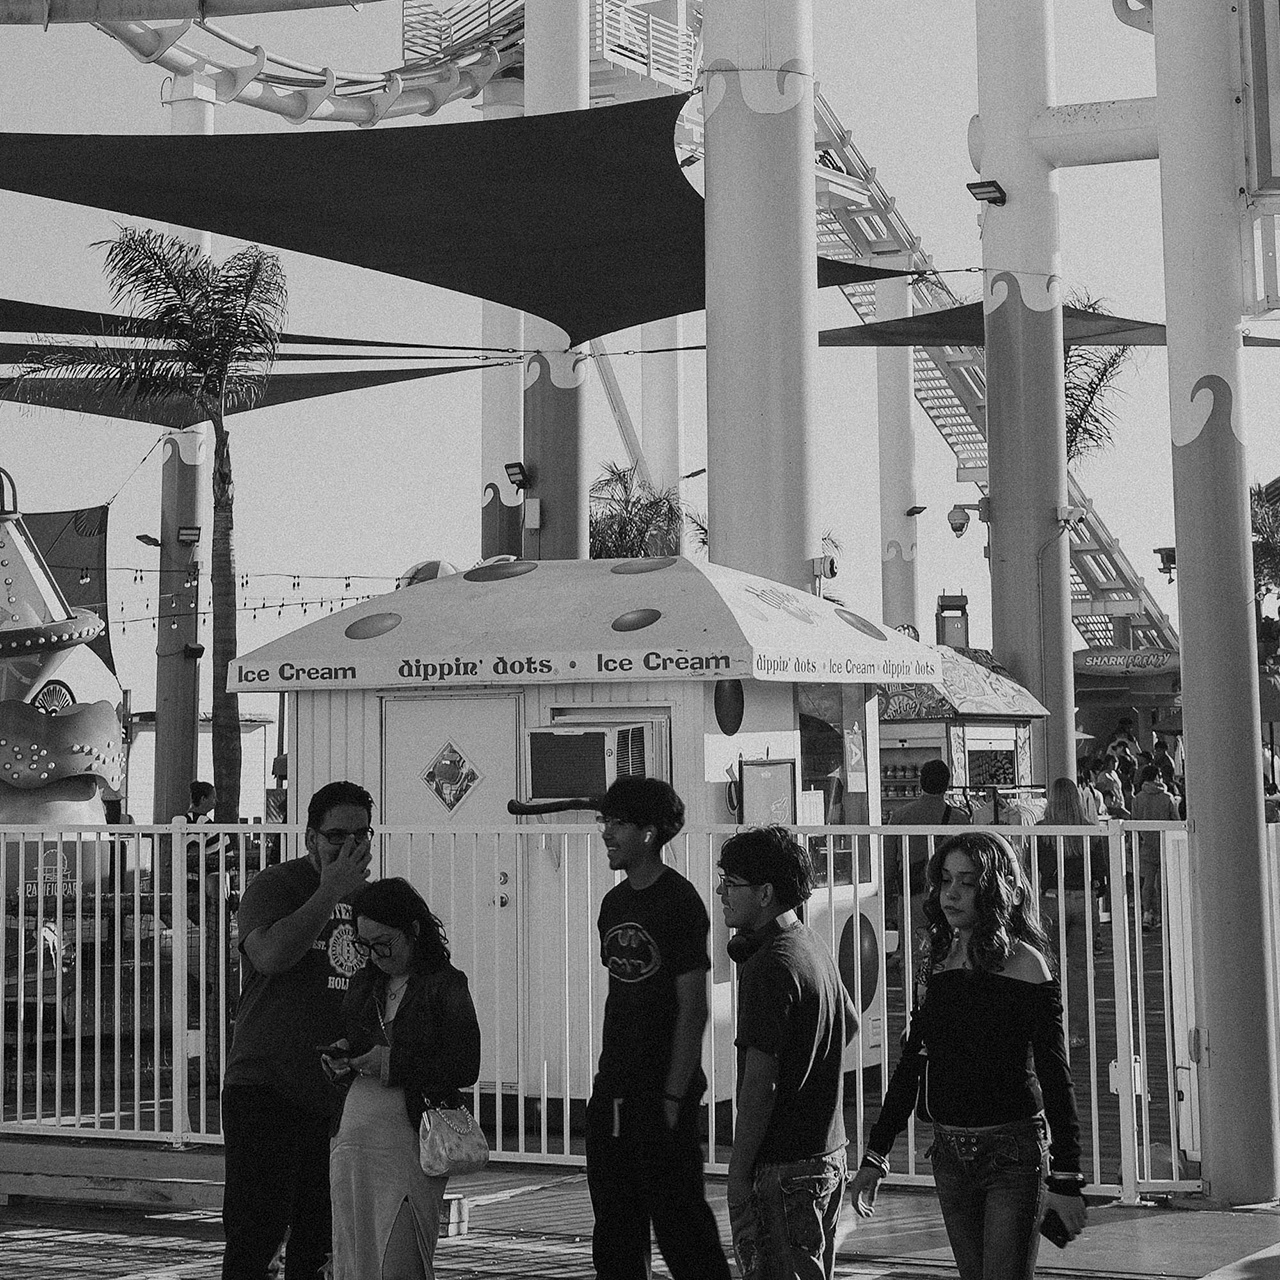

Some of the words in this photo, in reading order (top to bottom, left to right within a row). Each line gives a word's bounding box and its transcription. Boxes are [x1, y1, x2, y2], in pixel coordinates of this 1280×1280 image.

[237, 665, 270, 683] Ice
[278, 662, 357, 682] Cream
[398, 657, 484, 682] dippin'
[492, 655, 553, 675] dots
[597, 654, 634, 673] Ice
[643, 651, 731, 672] Cream
[756, 654, 792, 677] dippin'
[794, 657, 817, 673] dots
[829, 658, 843, 674] Ice
[845, 658, 875, 674] Cream
[882, 659, 913, 678] dippin'
[914, 659, 936, 676] dots
[1085, 656, 1125, 667] SHARK
[1125, 651, 1172, 669] FRENZY
